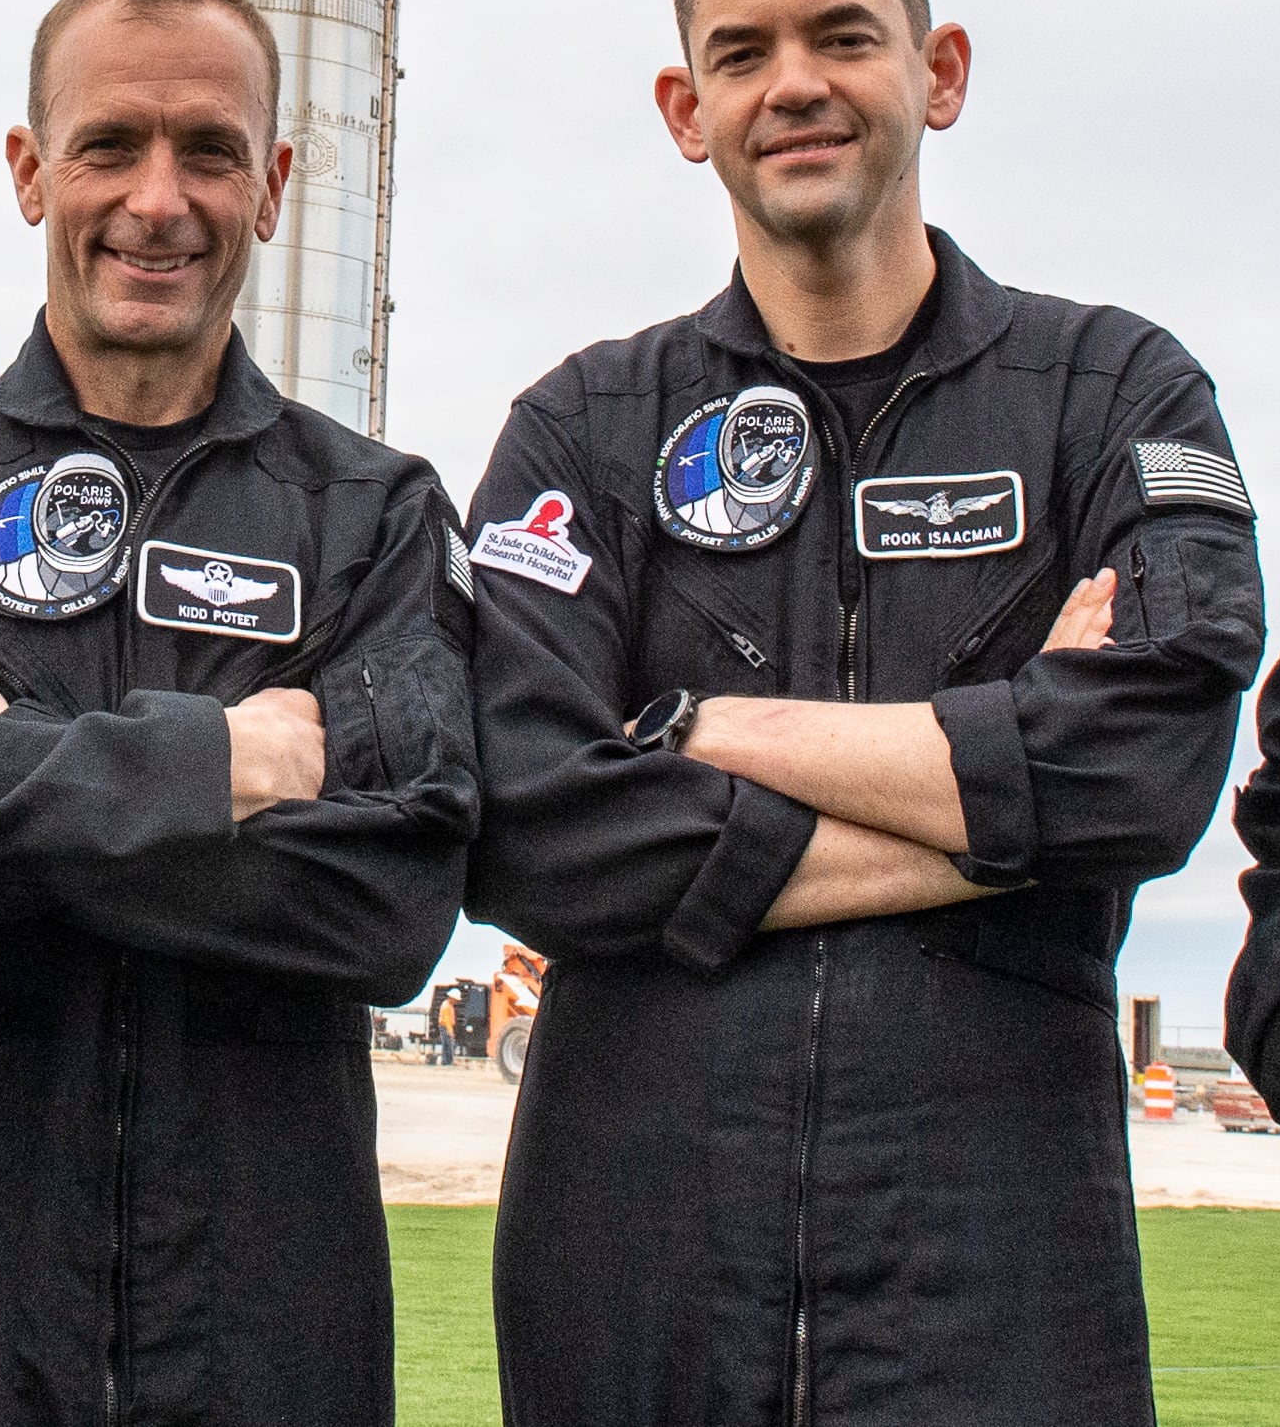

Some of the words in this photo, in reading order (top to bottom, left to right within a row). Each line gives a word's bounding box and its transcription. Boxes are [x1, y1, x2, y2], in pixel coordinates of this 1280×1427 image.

[738, 416, 795, 427] POLARIS
[763, 425, 795, 435] DAWN
[54, 485, 113, 497] POLARIS
[791, 466, 814, 507] MENON
[80, 495, 112, 506] DAWN
[680, 529, 725, 547] POTEET
[745, 524, 780, 545] GILLIS
[880, 531, 921, 546] ROOK
[928, 525, 1002, 545] ISAACMAN
[481, 544, 525, 564] Research
[526, 556, 574, 582] Hospital
[498, 535, 522, 552] Jude
[523, 542, 579, 571] Children's
[61, 595, 97, 614] GILLIS
[178, 604, 208, 620] KIDD
[213, 610, 259, 627] POTEET
